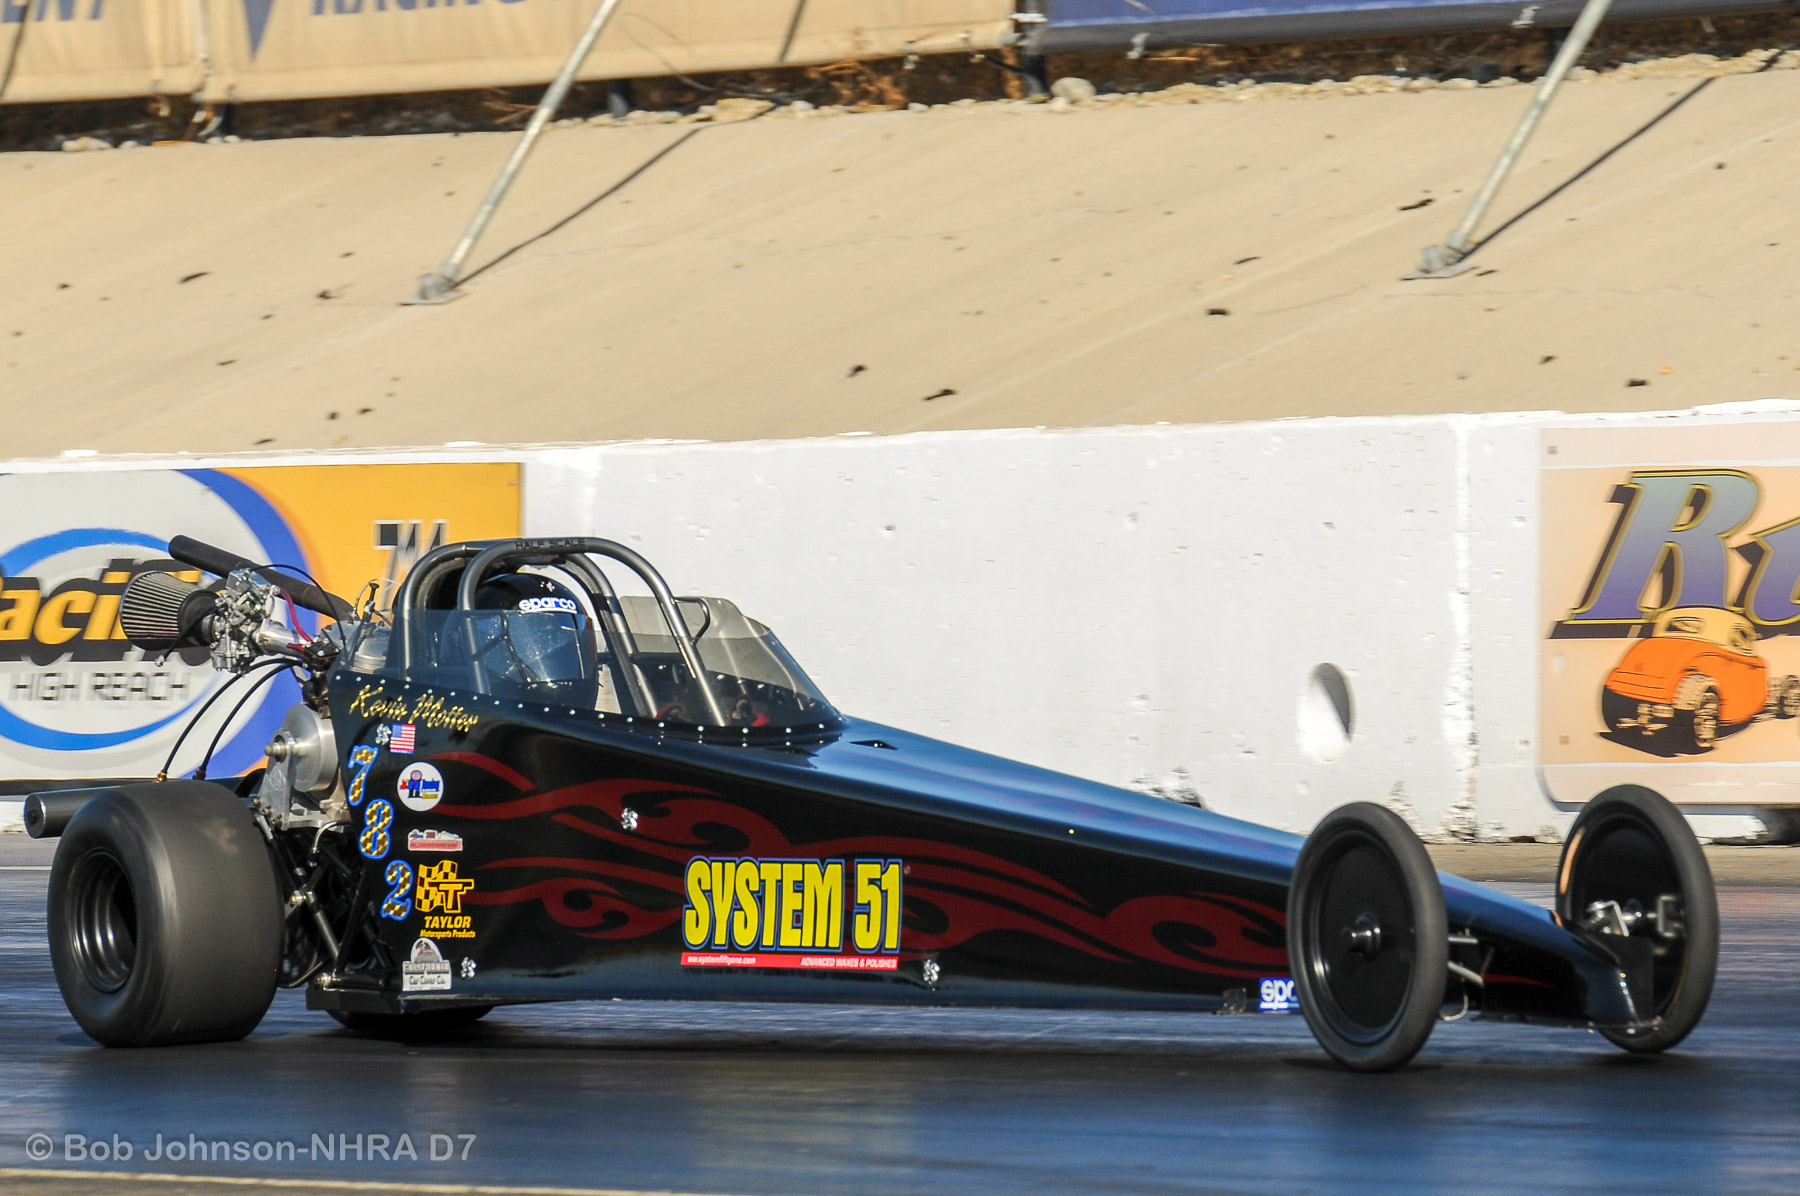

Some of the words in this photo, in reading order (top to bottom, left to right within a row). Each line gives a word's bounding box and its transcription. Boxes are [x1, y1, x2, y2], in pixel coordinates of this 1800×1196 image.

[515, 541, 545, 550] HALF
[549, 539, 585, 548] SCALE
[518, 597, 577, 612] sparco
[8, 672, 80, 701] HIGH
[89, 672, 190, 701] REACH
[683, 856, 844, 952] SYSTEM
[853, 859, 902, 953] 51
[424, 915, 472, 929] TAYLOR
[420, 929, 452, 939] Motorsports
[452, 929, 476, 938] Products
[800, 957, 835, 966] ADVANCED
[836, 958, 859, 967] WAXES
[866, 959, 897, 968] POLISHES
